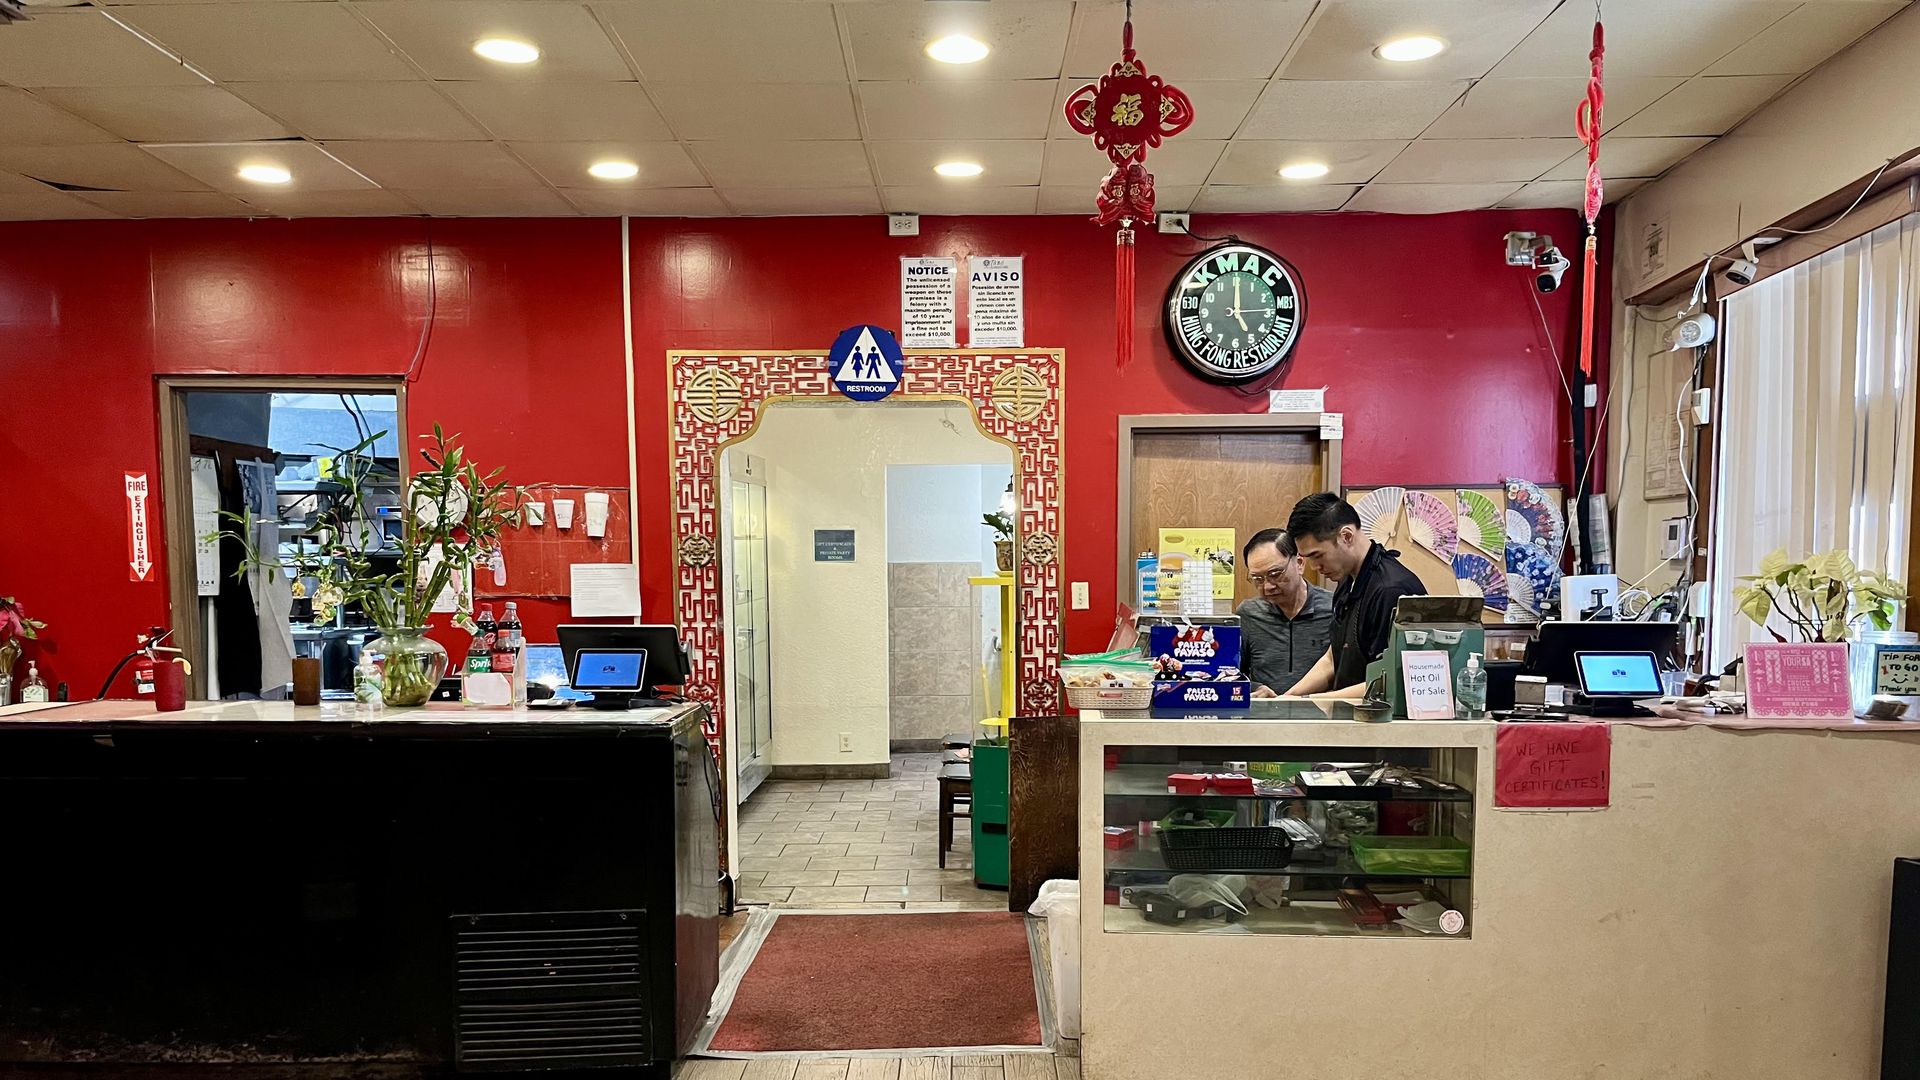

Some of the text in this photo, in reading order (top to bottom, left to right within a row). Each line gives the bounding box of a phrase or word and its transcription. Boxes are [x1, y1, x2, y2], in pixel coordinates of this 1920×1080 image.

[1111, 93, 1144, 126] 福
[908, 267, 949, 275] NOTICE
[1194, 253, 1283, 287] KMAC
[972, 272, 1019, 281] AVISO
[1217, 282, 1223, 291] 11
[1250, 282, 1254, 292] 1
[1182, 297, 1198, 309] 630
[1206, 294, 1214, 303] 10
[1261, 294, 1266, 303] 2
[1277, 296, 1293, 309] MBS
[1201, 308, 1209, 318] 9
[1264, 308, 1270, 318] 3
[1206, 323, 1213, 333] 8
[1258, 323, 1265, 332] 4
[1182, 315, 1292, 368] HUNG FONG RESTAURANT
[1217, 334, 1223, 343] 7
[1232, 339, 1239, 348] 6
[1248, 334, 1255, 343] 5
[128, 481, 146, 491] FIRE
[134, 496, 145, 573] EXTINGUISHER
[1177, 641, 1211, 649] PALETA
[1174, 648, 1215, 657] PAYASO
[1783, 656, 1800, 666] YOUR
[1904, 663, 1919, 671] GO
[1410, 674, 1440, 682] Hot Oil
[1184, 693, 1218, 701] PAYASO
[1516, 741, 1581, 756] WE HAVE
[1530, 759, 1571, 776] GIFT
[1505, 770, 1605, 794] CERTIFICATES!
